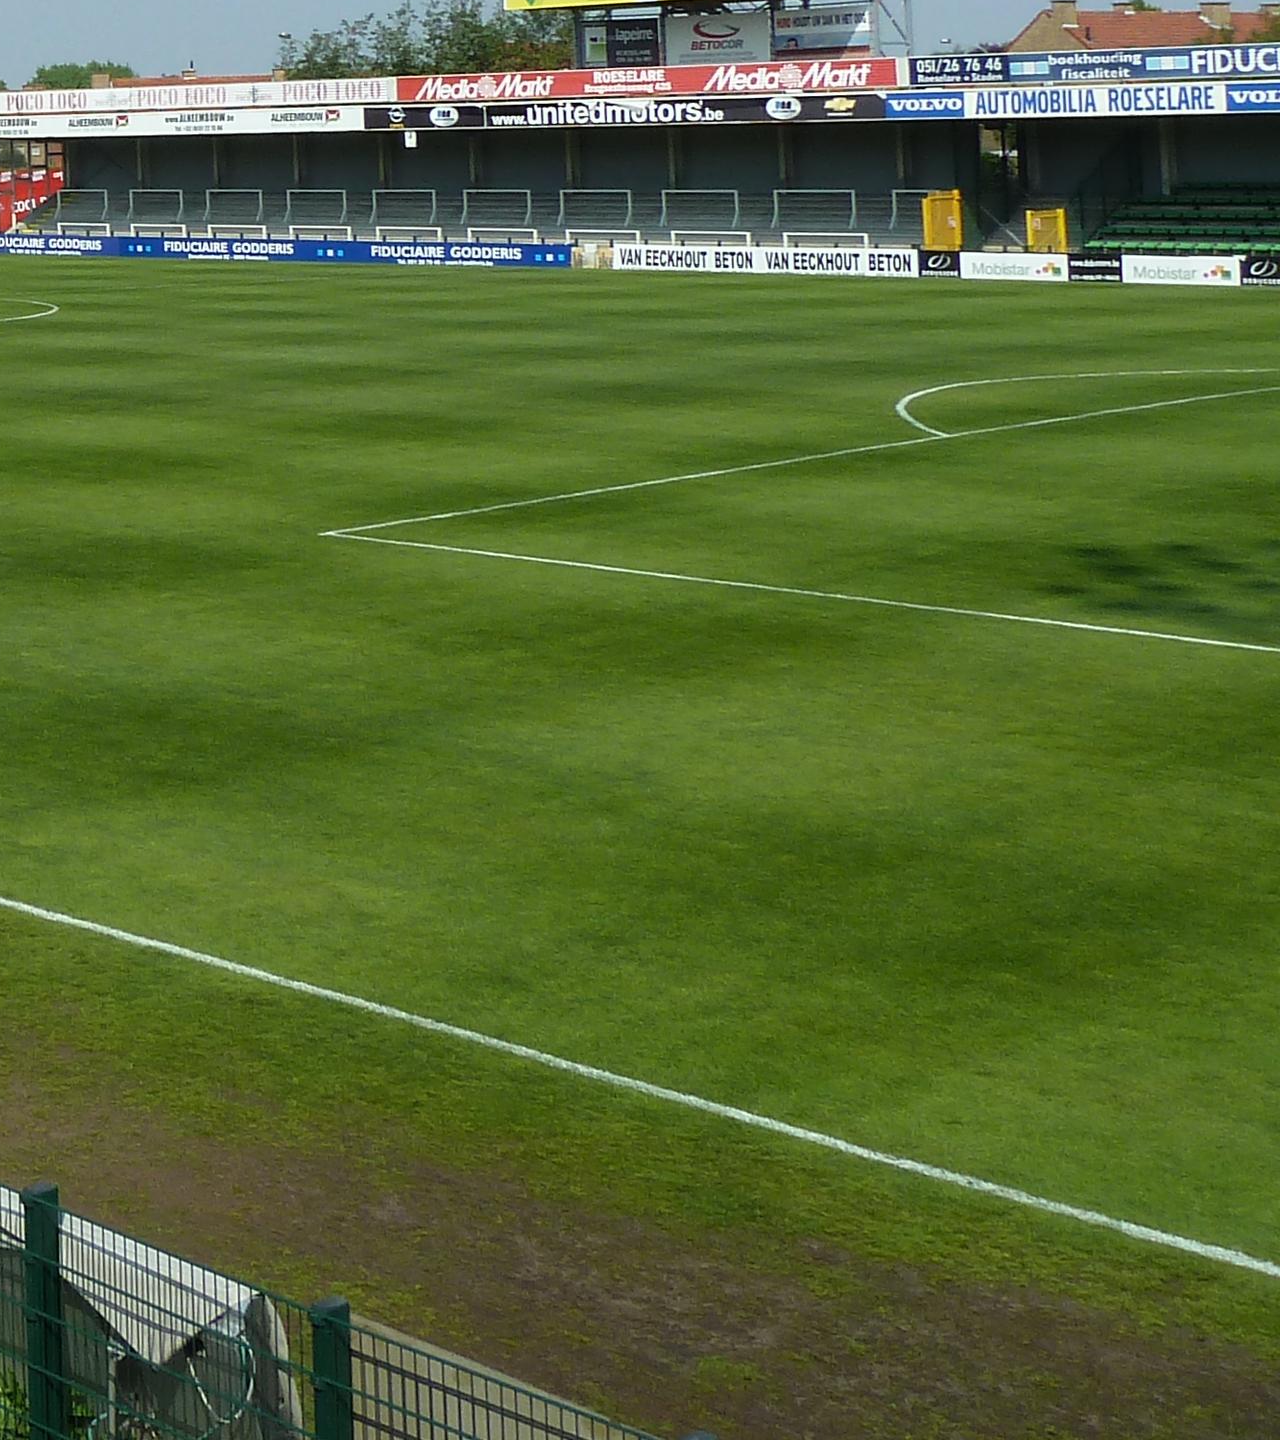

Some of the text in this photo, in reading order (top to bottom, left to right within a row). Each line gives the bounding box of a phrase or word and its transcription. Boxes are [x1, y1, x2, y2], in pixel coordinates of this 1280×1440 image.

[916, 56, 1003, 73] 051/26 76 46
[593, 69, 666, 84] ROESELARE
[1061, 67, 1131, 80] fiscaliteit
[138, 88, 178, 107] POCO
[185, 86, 226, 105] LOCO
[282, 81, 327, 103] POCO
[7, 94, 44, 111] POCO
[888, 98, 962, 111] VOLVO
[976, 86, 1215, 115] AUTOMOBILIA ROESELARE
[48, 238, 102, 251] GODDERIS
[164, 241, 293, 255] FIDUCIAIRE GODDERIS
[370, 245, 522, 260] FIDUCIAIRE GODDERIS
[619, 249, 912, 273] VAN EECKHOUT BETON VAN EECKHOUT BETON
[972, 263, 1030, 277] Mobistar
[1133, 265, 1197, 281] Mobistar
